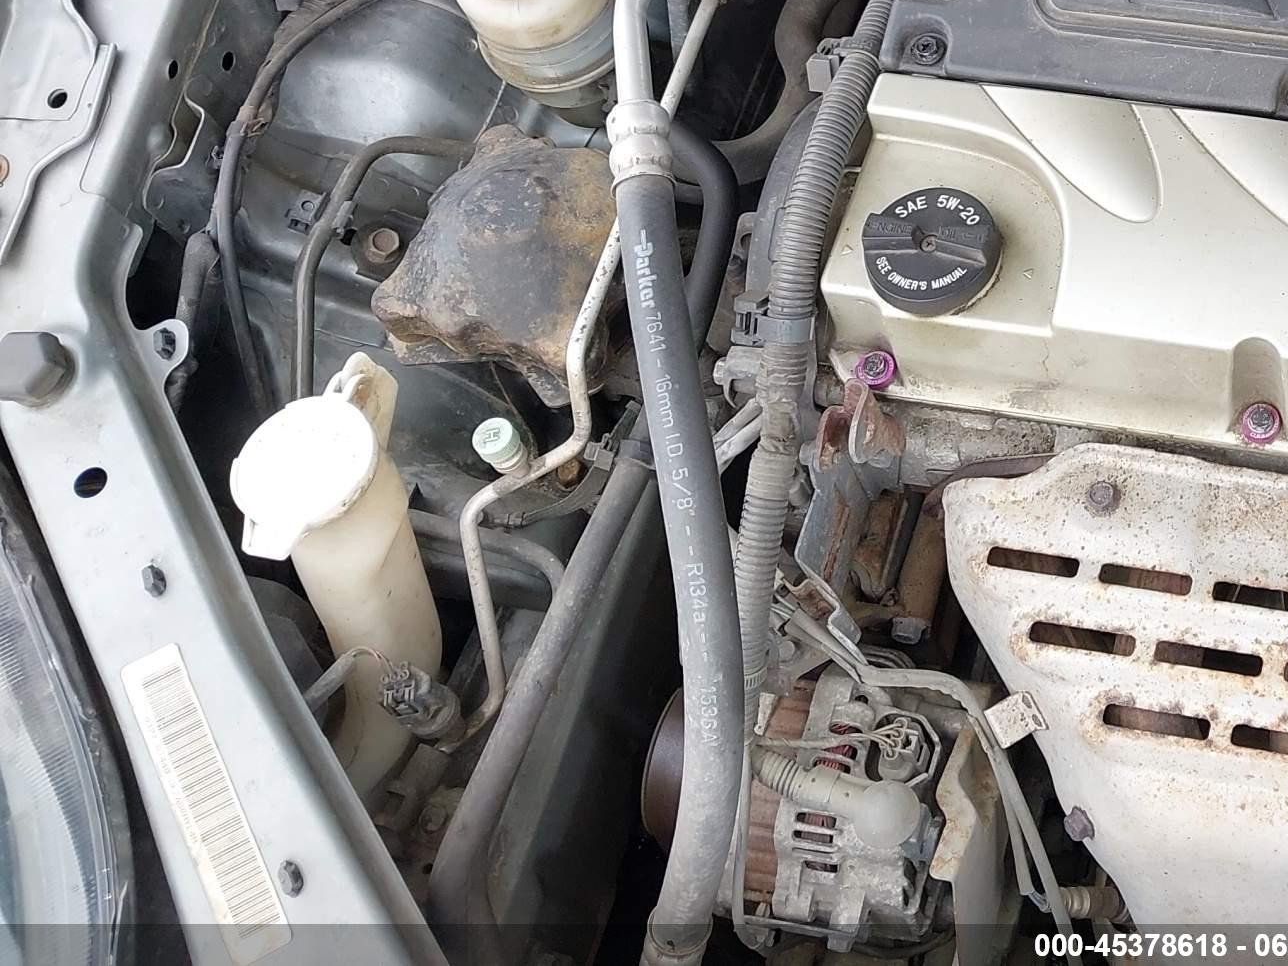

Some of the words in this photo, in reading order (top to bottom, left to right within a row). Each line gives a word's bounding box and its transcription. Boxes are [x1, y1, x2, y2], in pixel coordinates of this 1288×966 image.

[894, 196, 928, 219] SAE
[936, 194, 981, 226] 5W-20
[634, 229, 658, 309] Parker
[876, 256, 888, 276] SEE
[888, 272, 928, 292] OWNER'S
[932, 266, 968, 290] MANUAL
[645, 311, 667, 354] 7641
[654, 374, 676, 428] 16mm
[664, 432, 683, 464] I.D.
[686, 563, 706, 624] R134a
